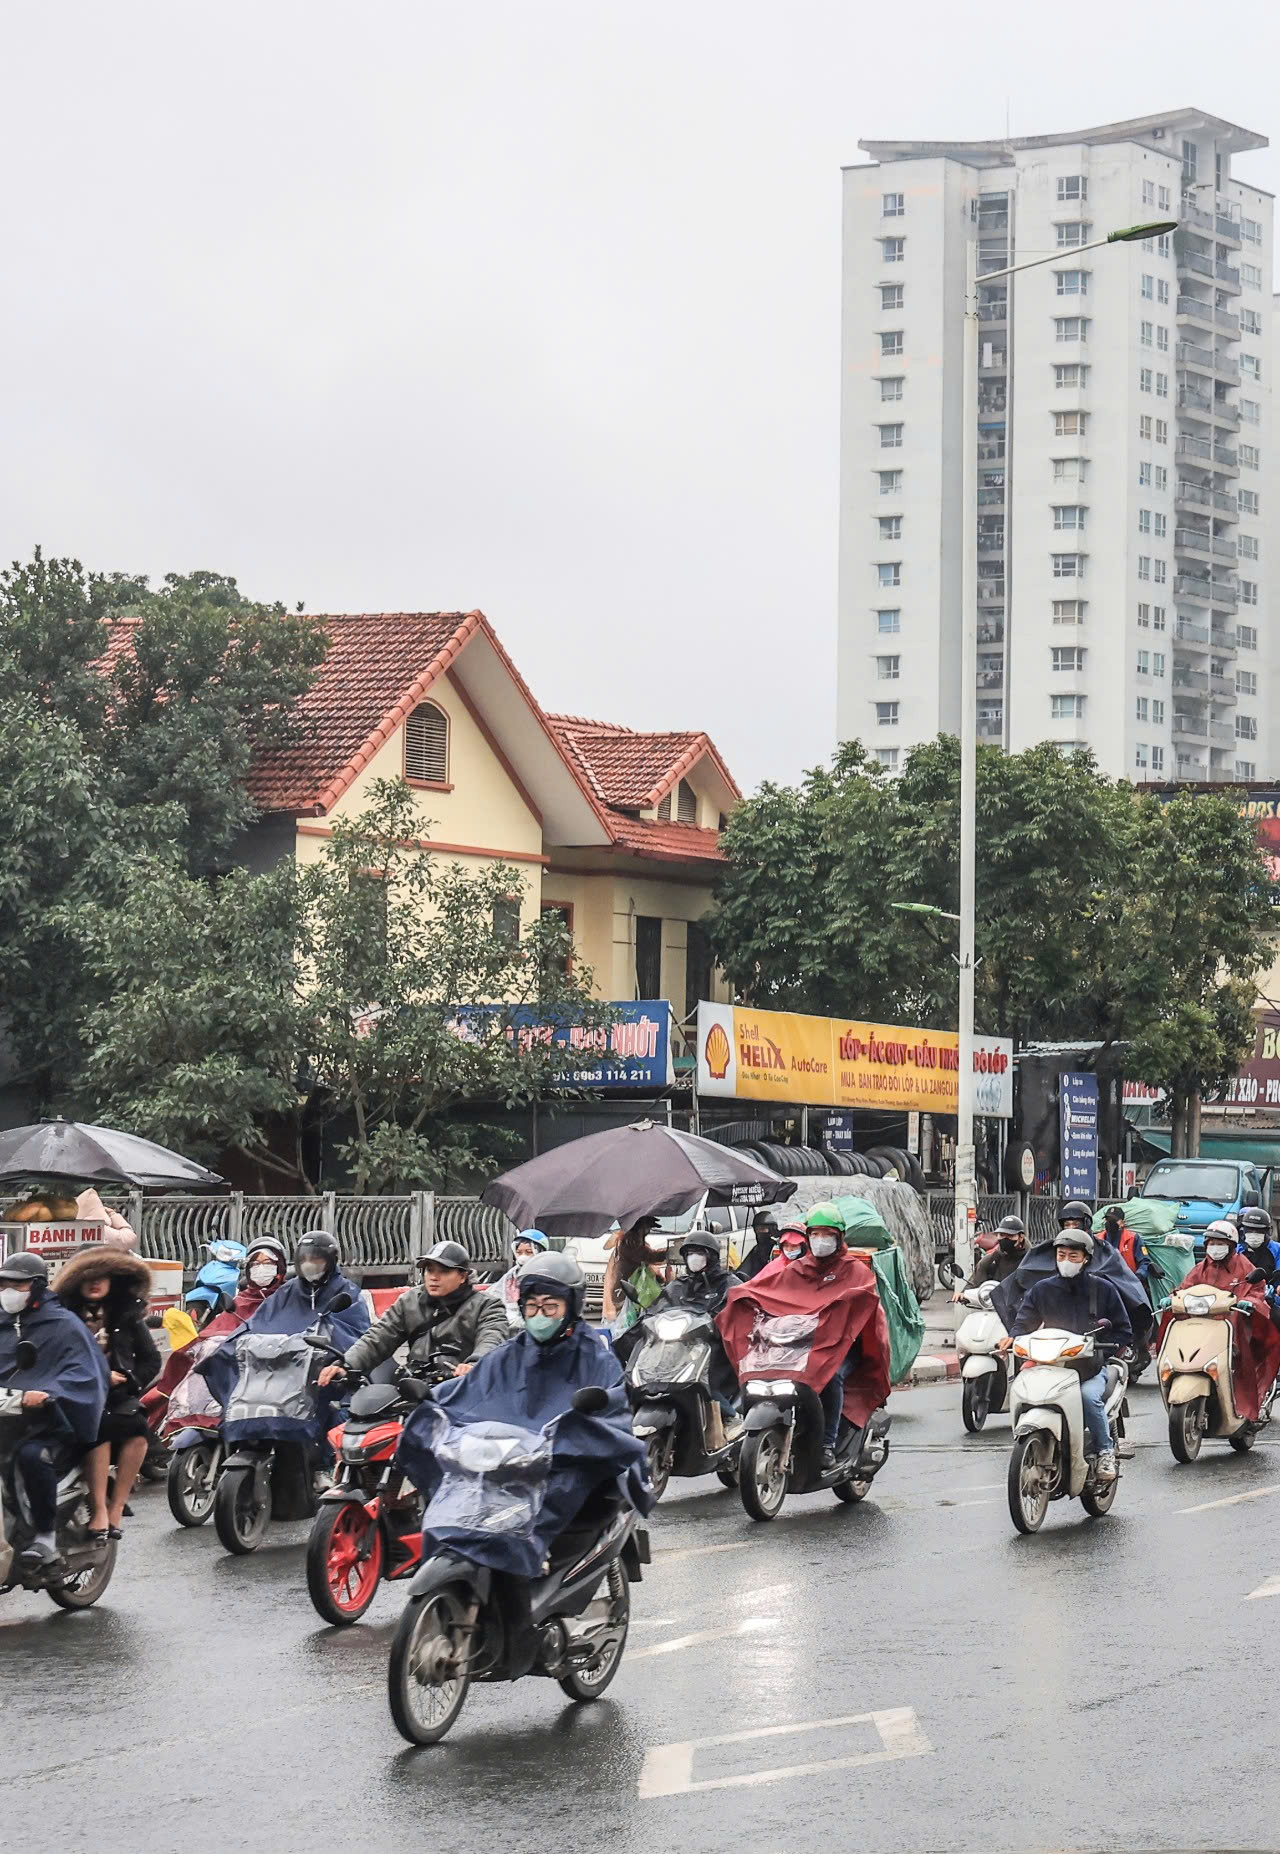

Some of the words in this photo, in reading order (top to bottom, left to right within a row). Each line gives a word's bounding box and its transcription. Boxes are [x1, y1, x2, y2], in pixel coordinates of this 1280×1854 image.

[739, 1023, 760, 1041] Shell
[740, 1039, 786, 1070] HELIX
[791, 1056, 828, 1074] AutoCare
[605, 1070, 627, 1081] 114
[629, 1070, 652, 1081] 211
[1071, 1115, 1096, 1124] MICHELIN
[29, 1226, 76, 1244] BÁNH
